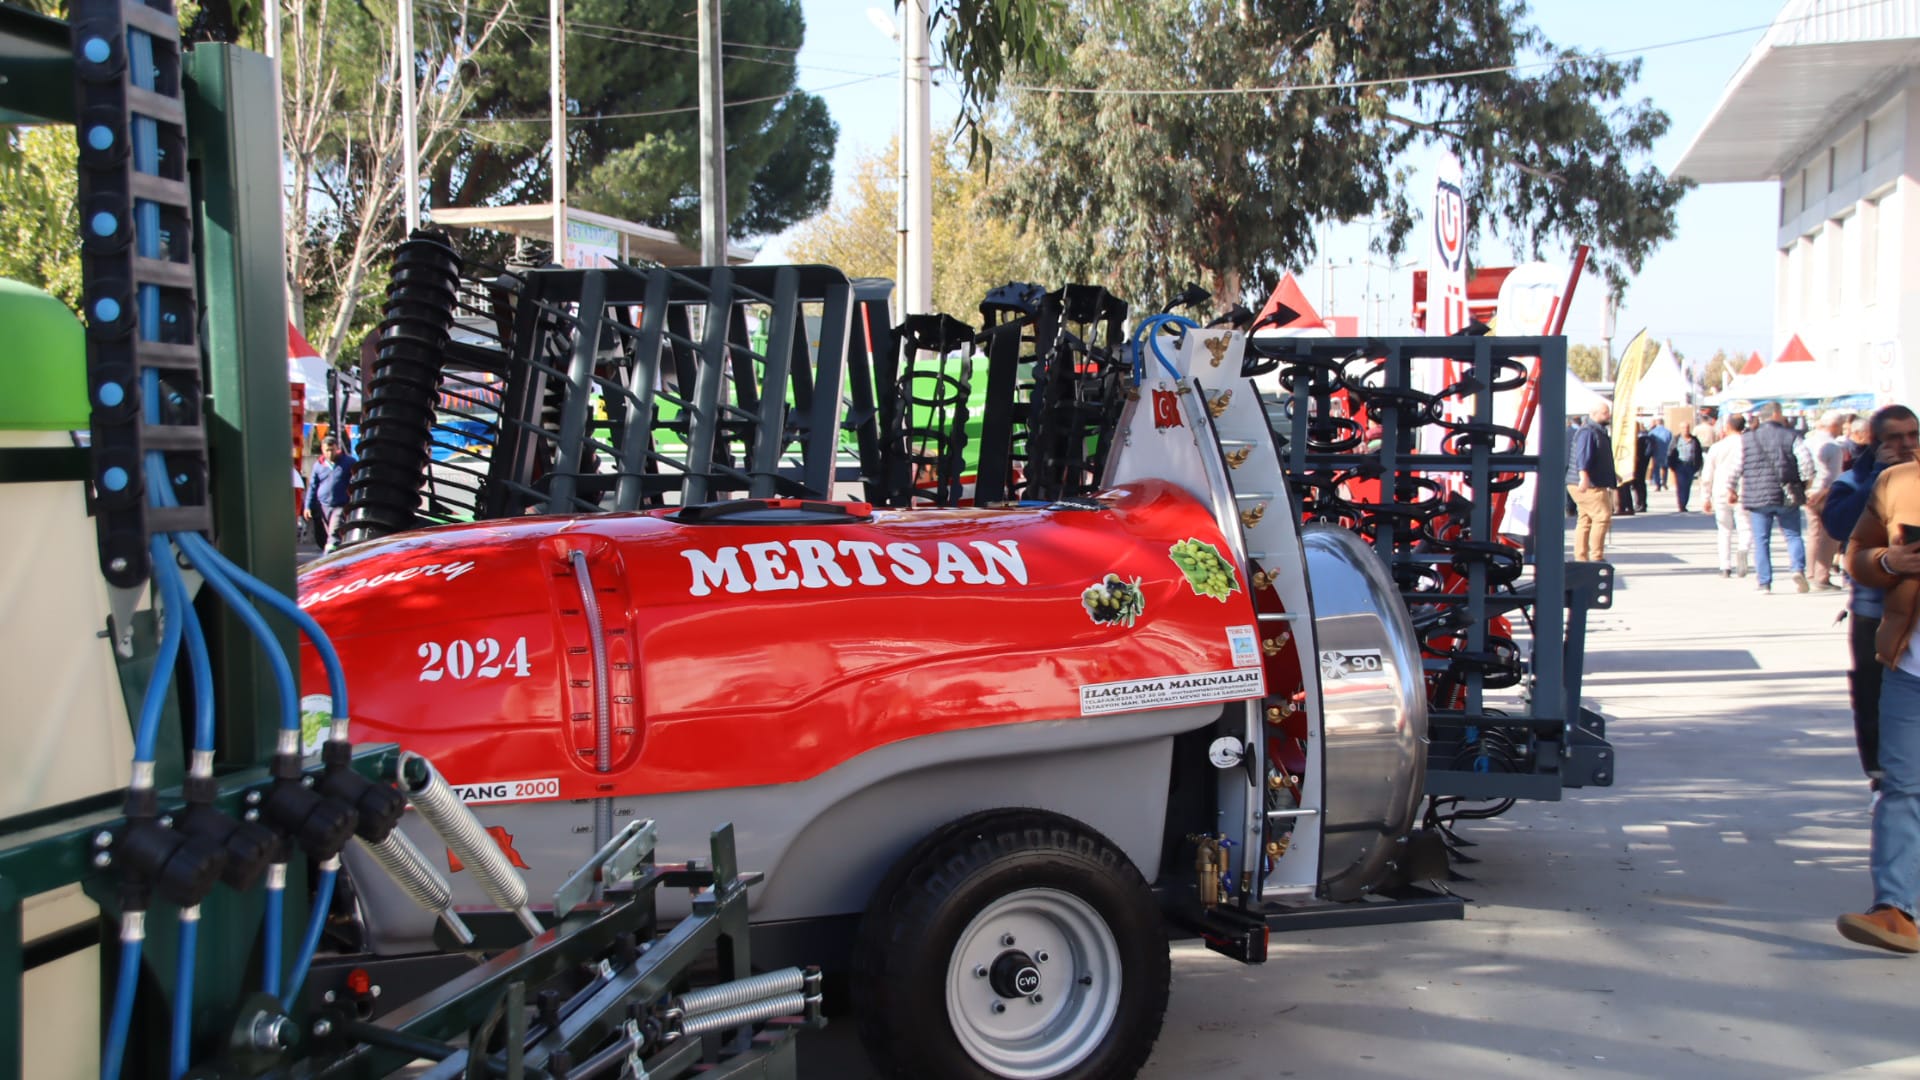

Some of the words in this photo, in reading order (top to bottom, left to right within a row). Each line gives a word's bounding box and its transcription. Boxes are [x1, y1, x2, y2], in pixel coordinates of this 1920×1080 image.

[680, 539, 1028, 597] MERTSAN
[417, 635, 531, 683] 2024
[1352, 657, 1378, 671] 90
[515, 781, 557, 796] 2000
